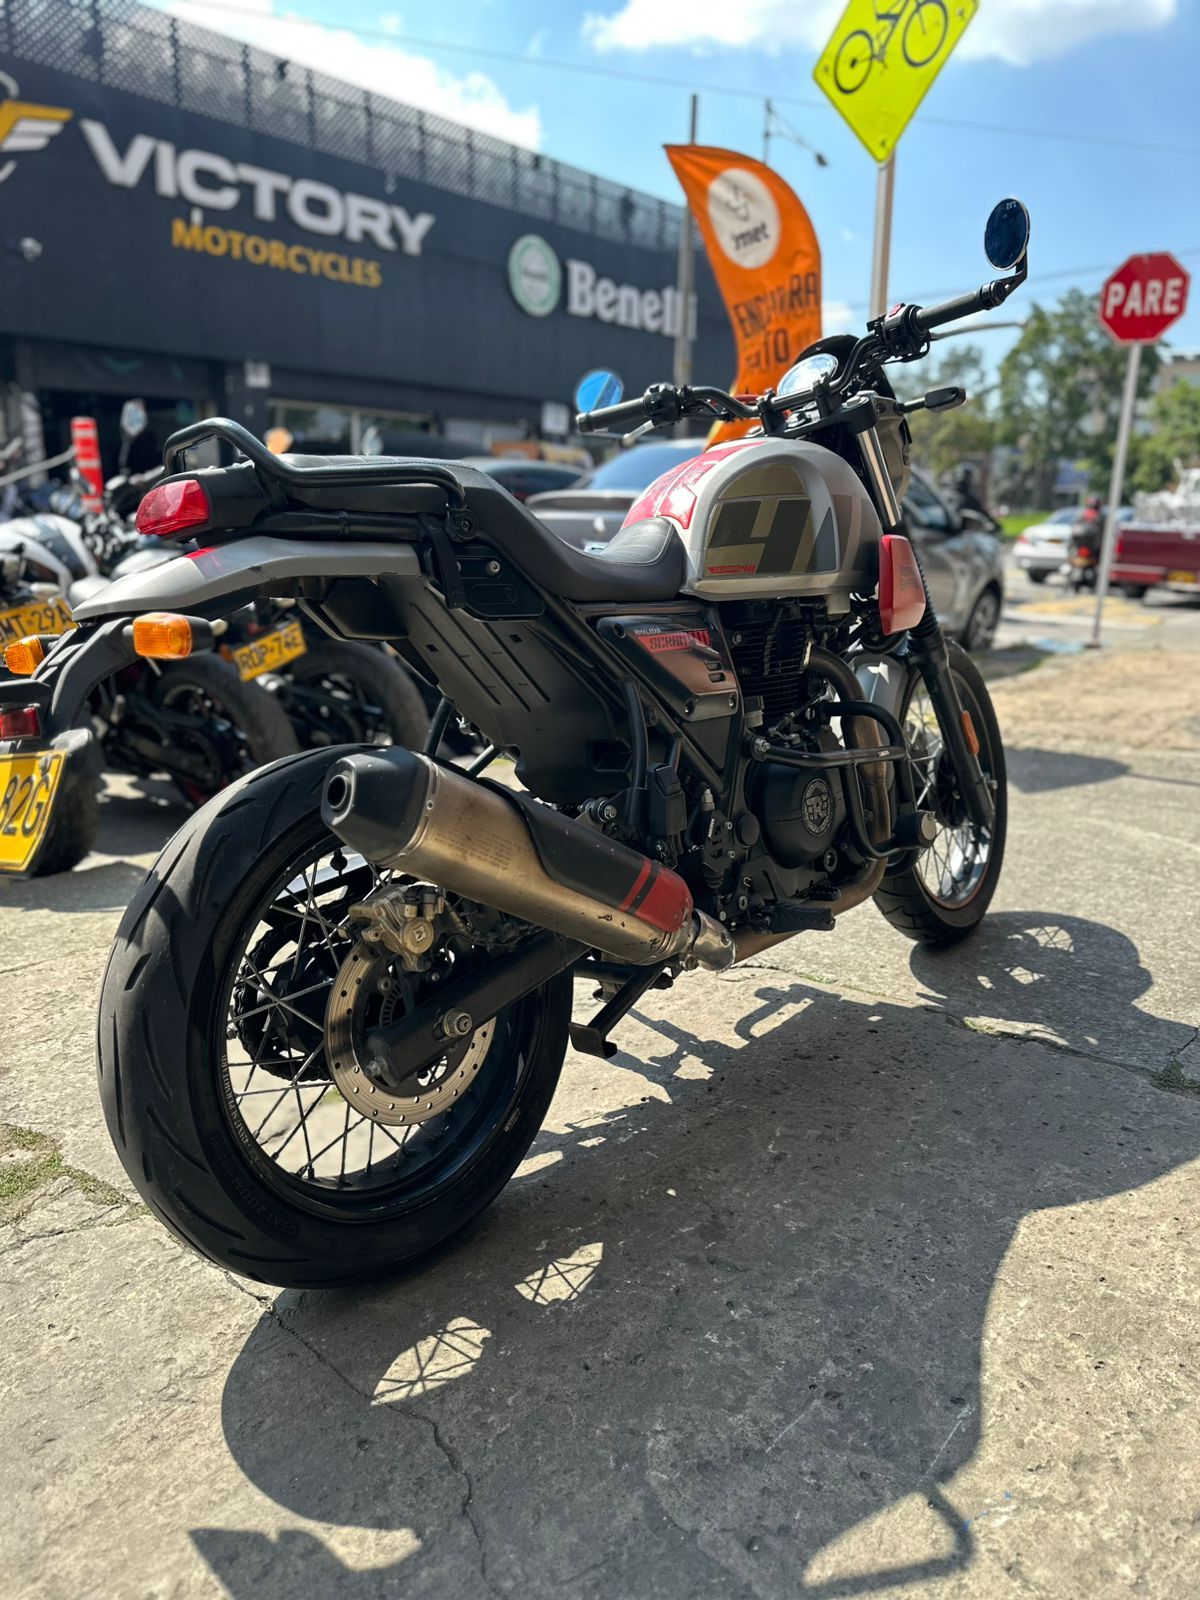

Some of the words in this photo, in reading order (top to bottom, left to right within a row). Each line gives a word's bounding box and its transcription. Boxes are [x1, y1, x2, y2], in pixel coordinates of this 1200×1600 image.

[80, 118, 436, 257] VICTORY
[171, 217, 383, 288] MOTORCYCLES
[1105, 277, 1184, 319] PARE
